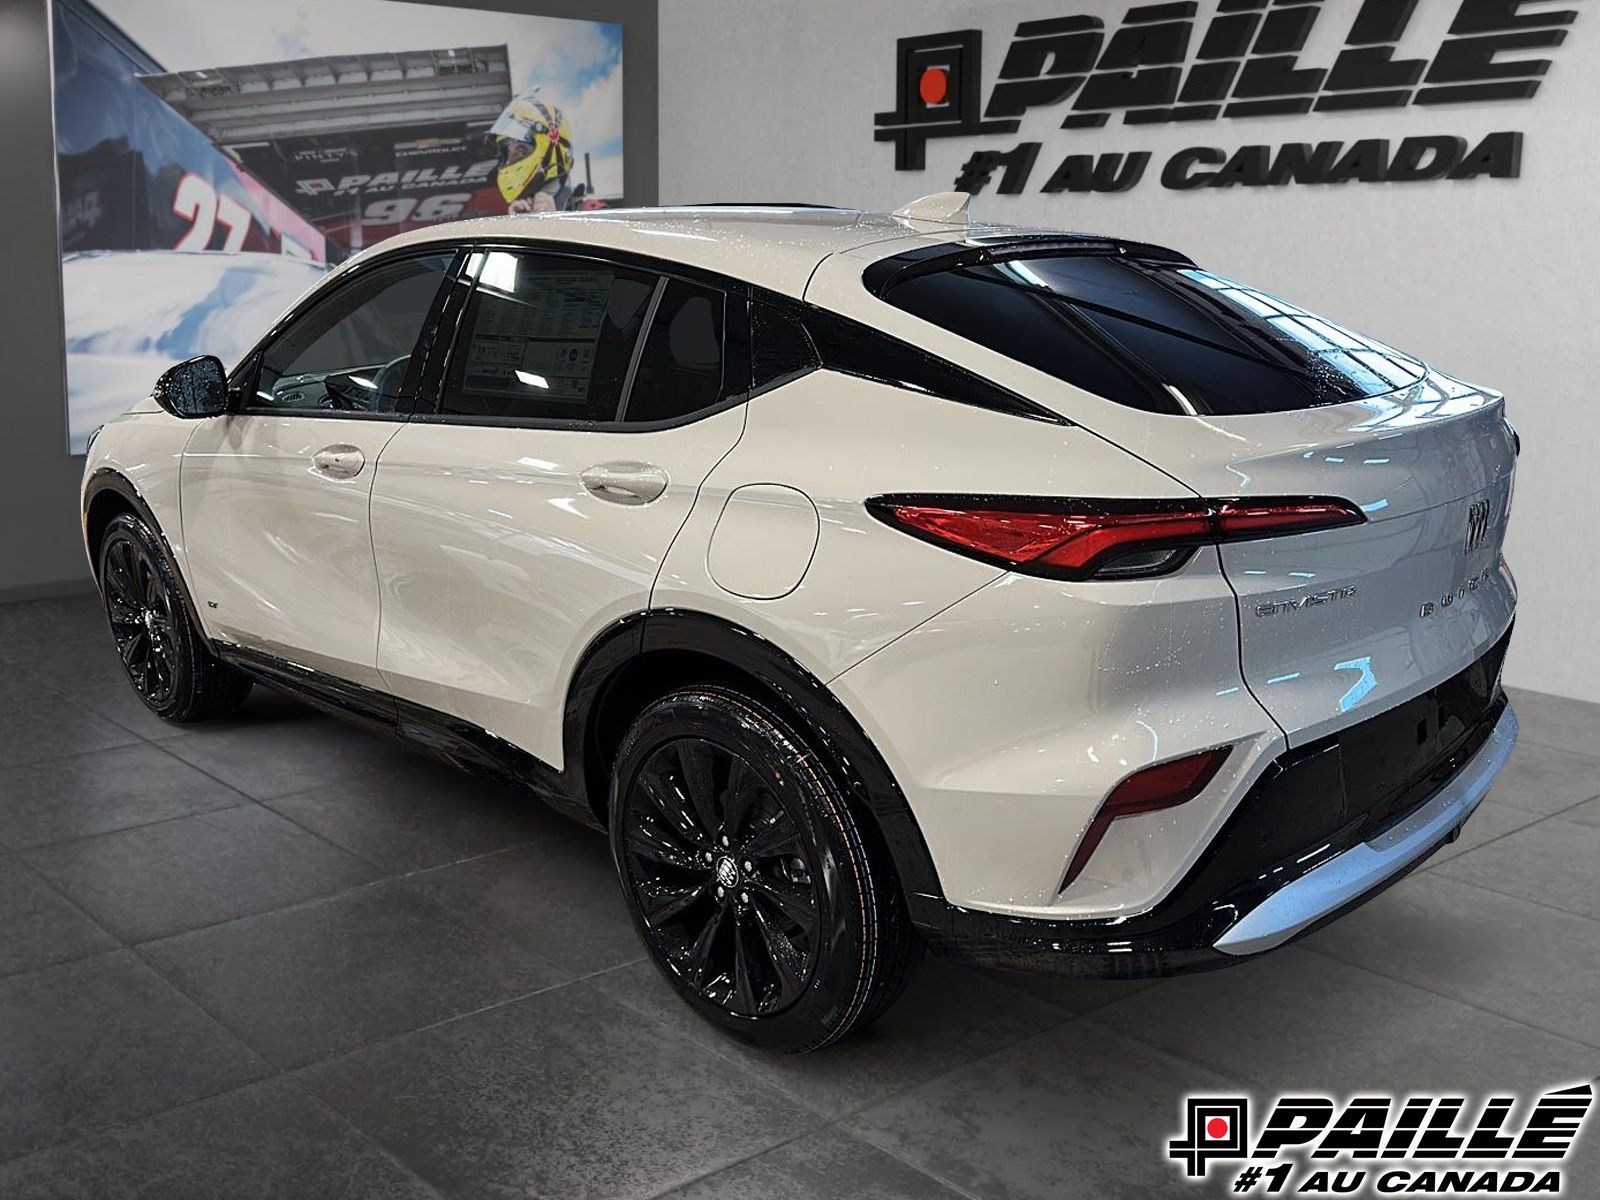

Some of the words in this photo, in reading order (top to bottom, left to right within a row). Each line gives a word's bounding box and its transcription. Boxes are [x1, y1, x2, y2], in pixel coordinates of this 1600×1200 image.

[365, 185, 395, 194] AU
[401, 176, 488, 190] CANADA
[954, 142, 1043, 195] #1
[1040, 151, 1152, 192] AU
[1160, 131, 1524, 190] CANADA
[172, 171, 253, 255] 27
[361, 193, 473, 226] 96
